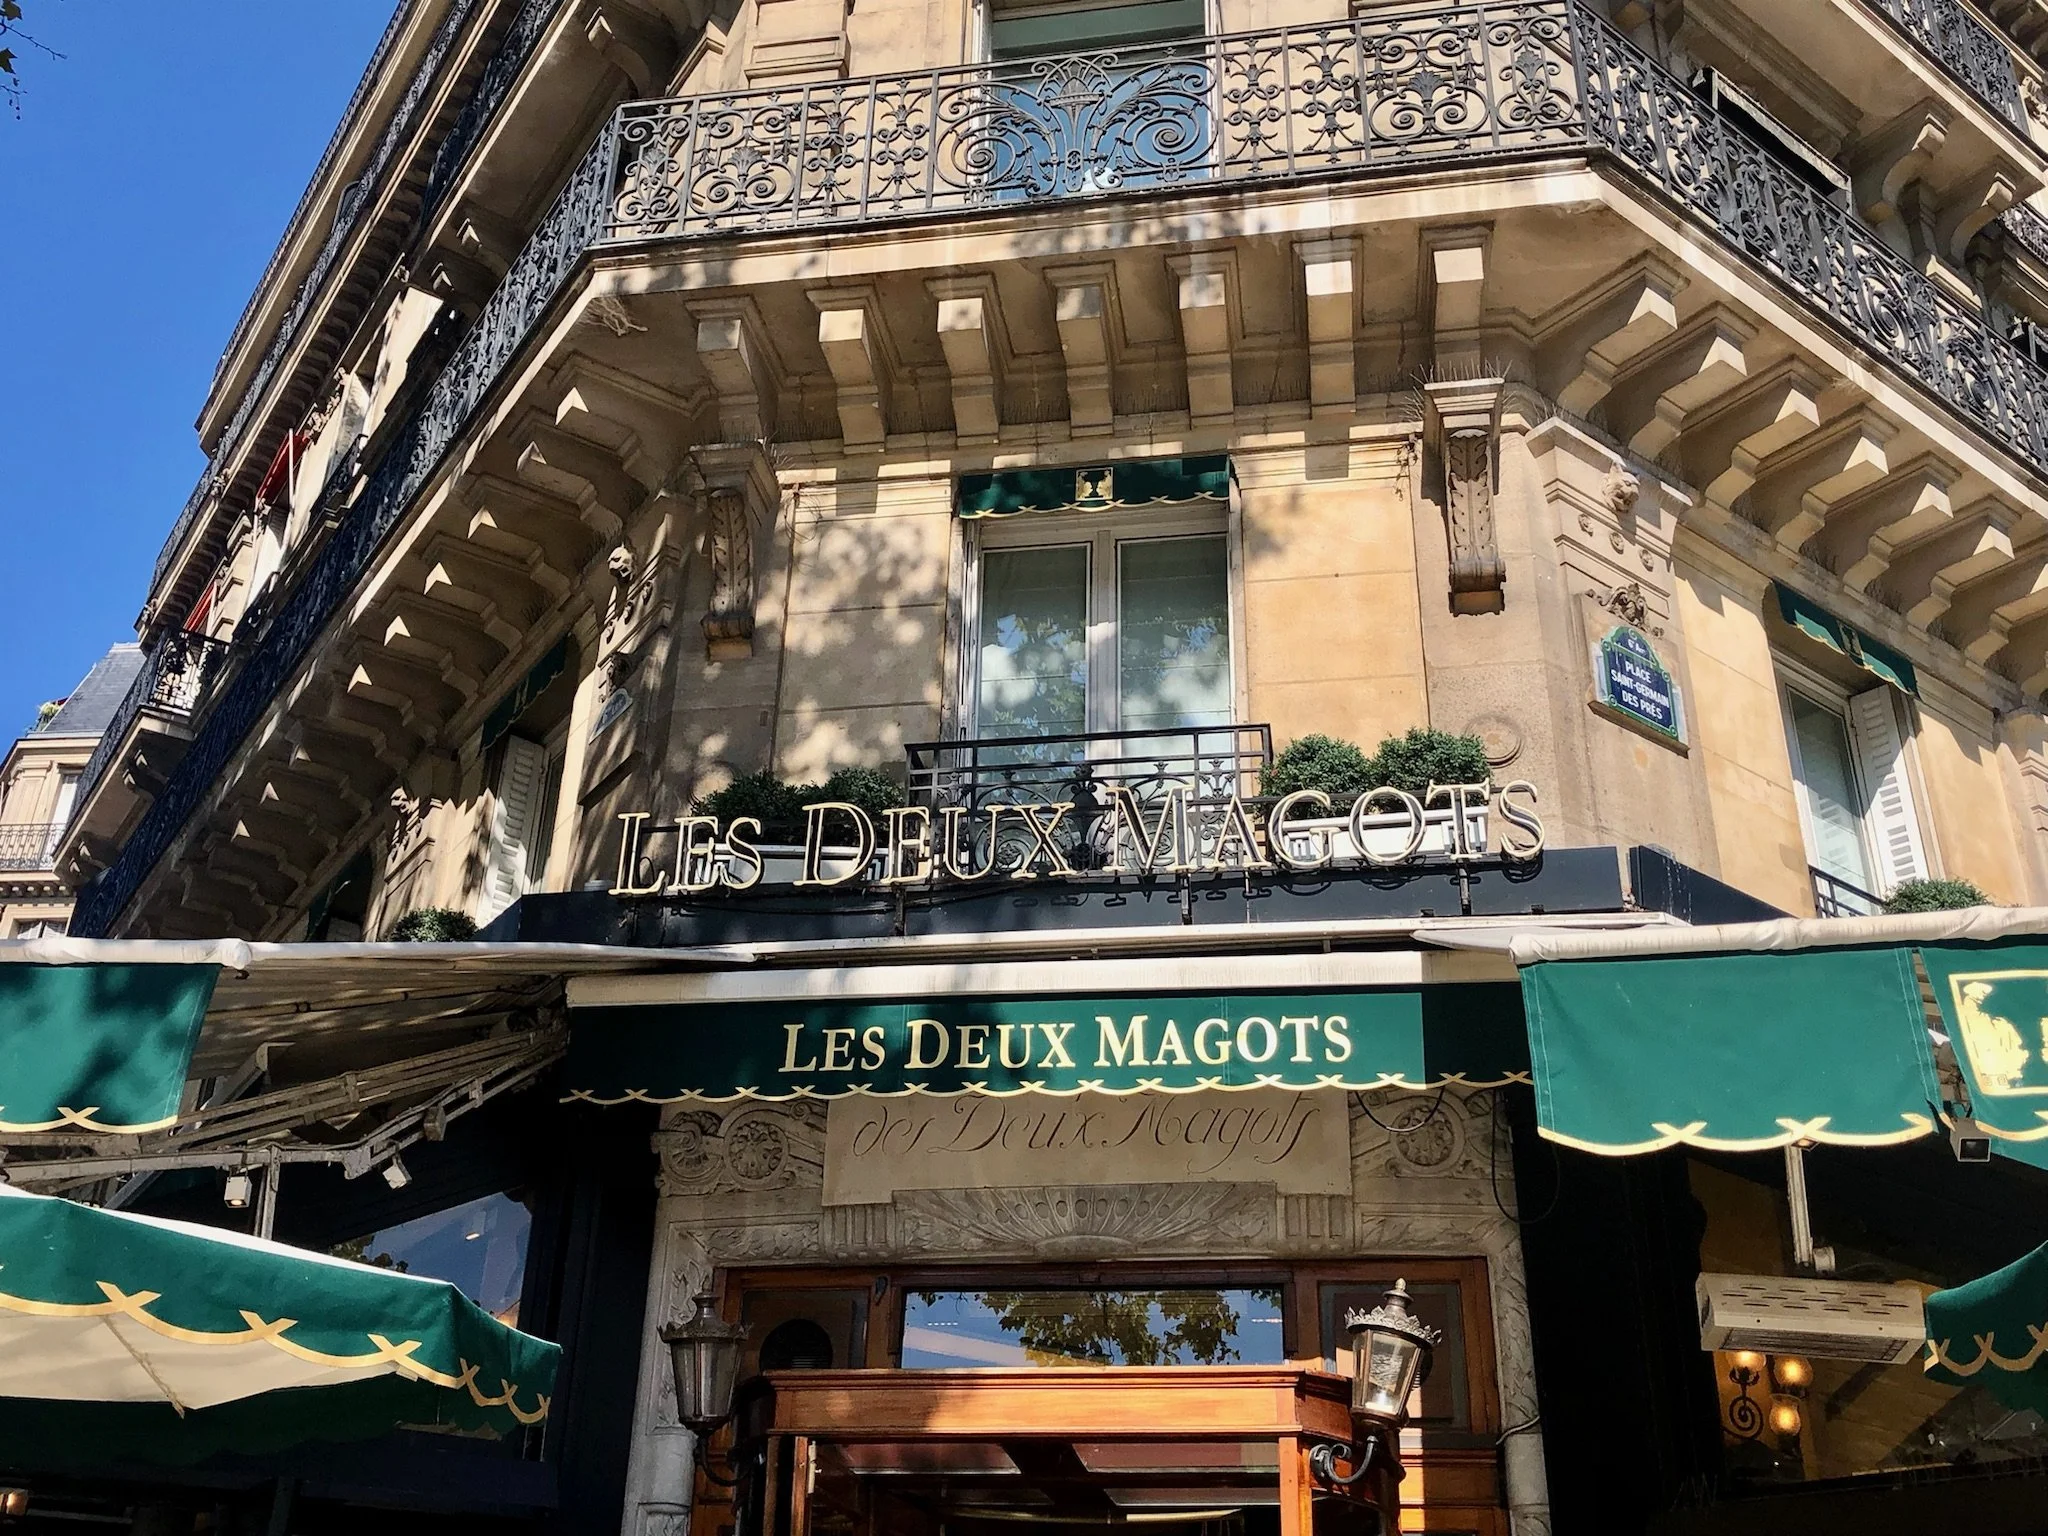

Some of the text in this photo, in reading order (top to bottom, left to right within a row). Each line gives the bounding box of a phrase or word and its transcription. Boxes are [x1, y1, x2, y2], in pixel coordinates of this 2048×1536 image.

[1611, 669, 1670, 708] SAINT-GERMAIN
[1624, 660, 1652, 683] PLACE
[1622, 689, 1639, 708] DES
[608, 777, 1546, 896] LES DEUX MAGOTS
[778, 1014, 1353, 1074] LES DEUX MAGOTS
[926, 1094, 1107, 1153] Deux
[1100, 1091, 1322, 1174] Magots
